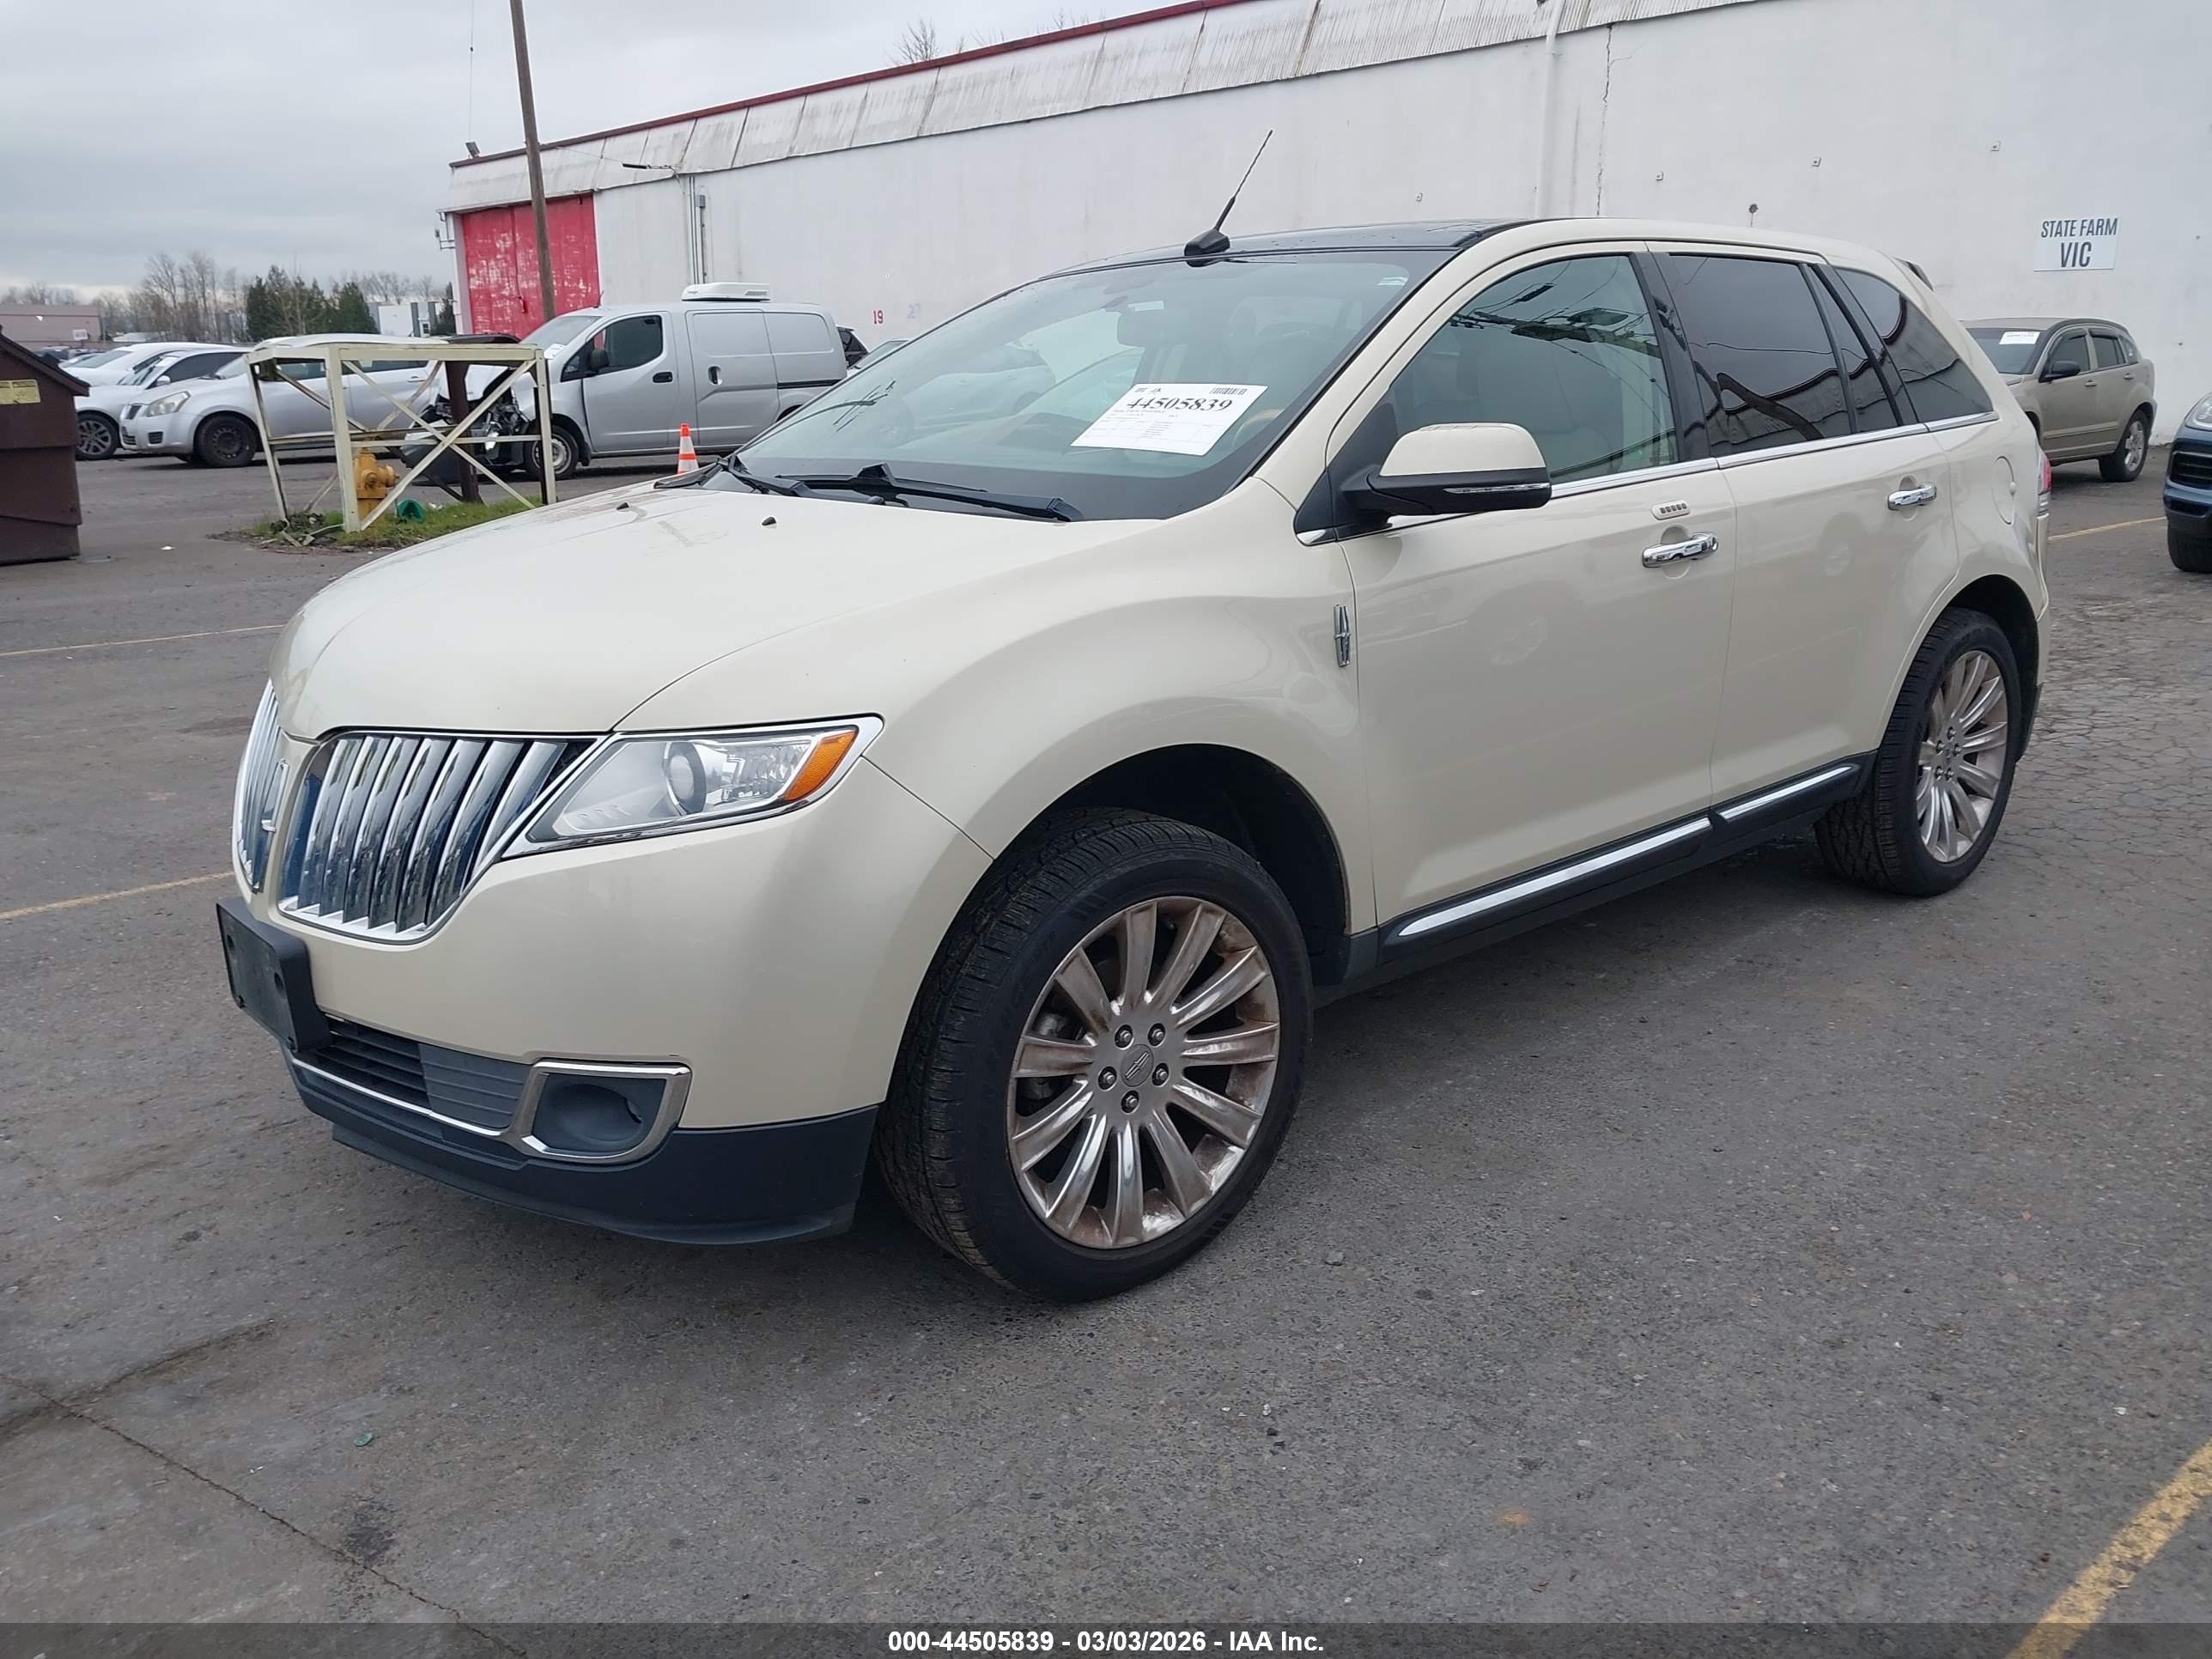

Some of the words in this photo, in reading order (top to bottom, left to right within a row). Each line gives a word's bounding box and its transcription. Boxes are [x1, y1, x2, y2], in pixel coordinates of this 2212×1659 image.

[2041, 220, 2077, 238] STATE
[2080, 218, 2118, 236] FARM
[2061, 241, 2092, 268] VIC
[873, 310, 884, 325] 19
[1127, 397, 1233, 411] 44505839
